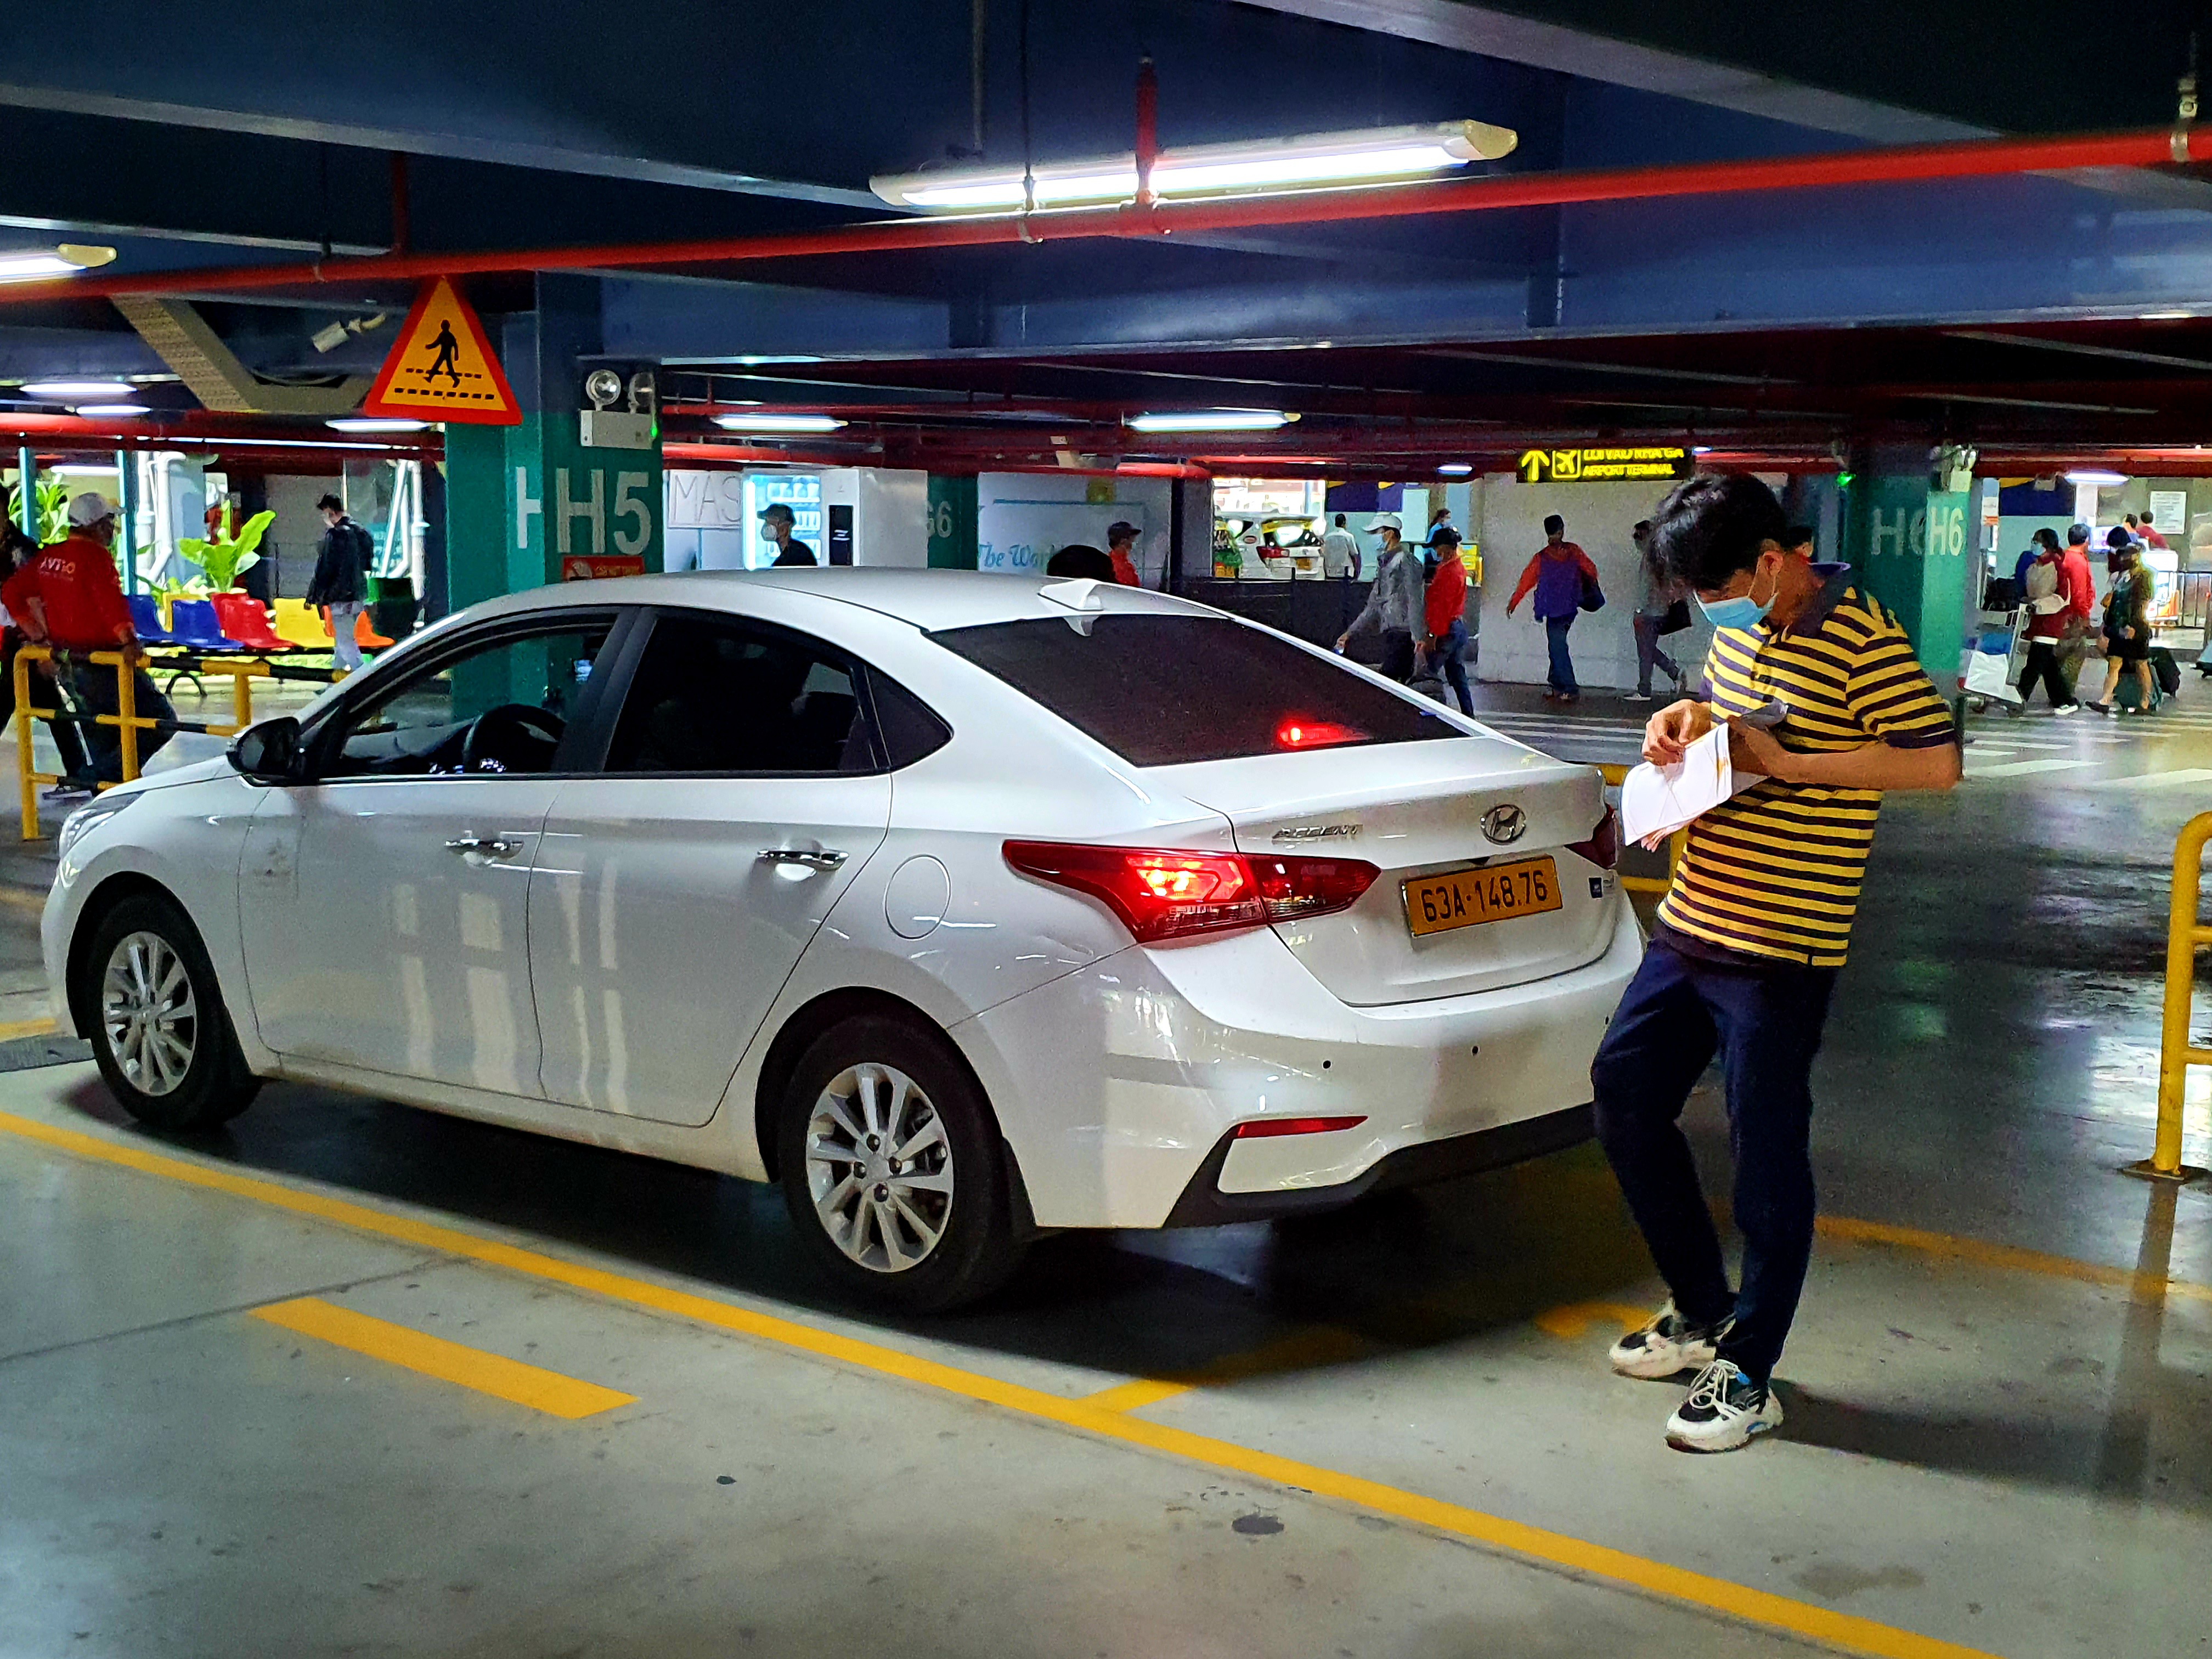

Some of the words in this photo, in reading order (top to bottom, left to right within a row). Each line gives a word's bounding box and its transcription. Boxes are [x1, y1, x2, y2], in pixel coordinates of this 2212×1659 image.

[1627, 464, 1675, 475] TERMINAL
[556, 467, 652, 555] H5
[1928, 506, 1964, 556] H6
